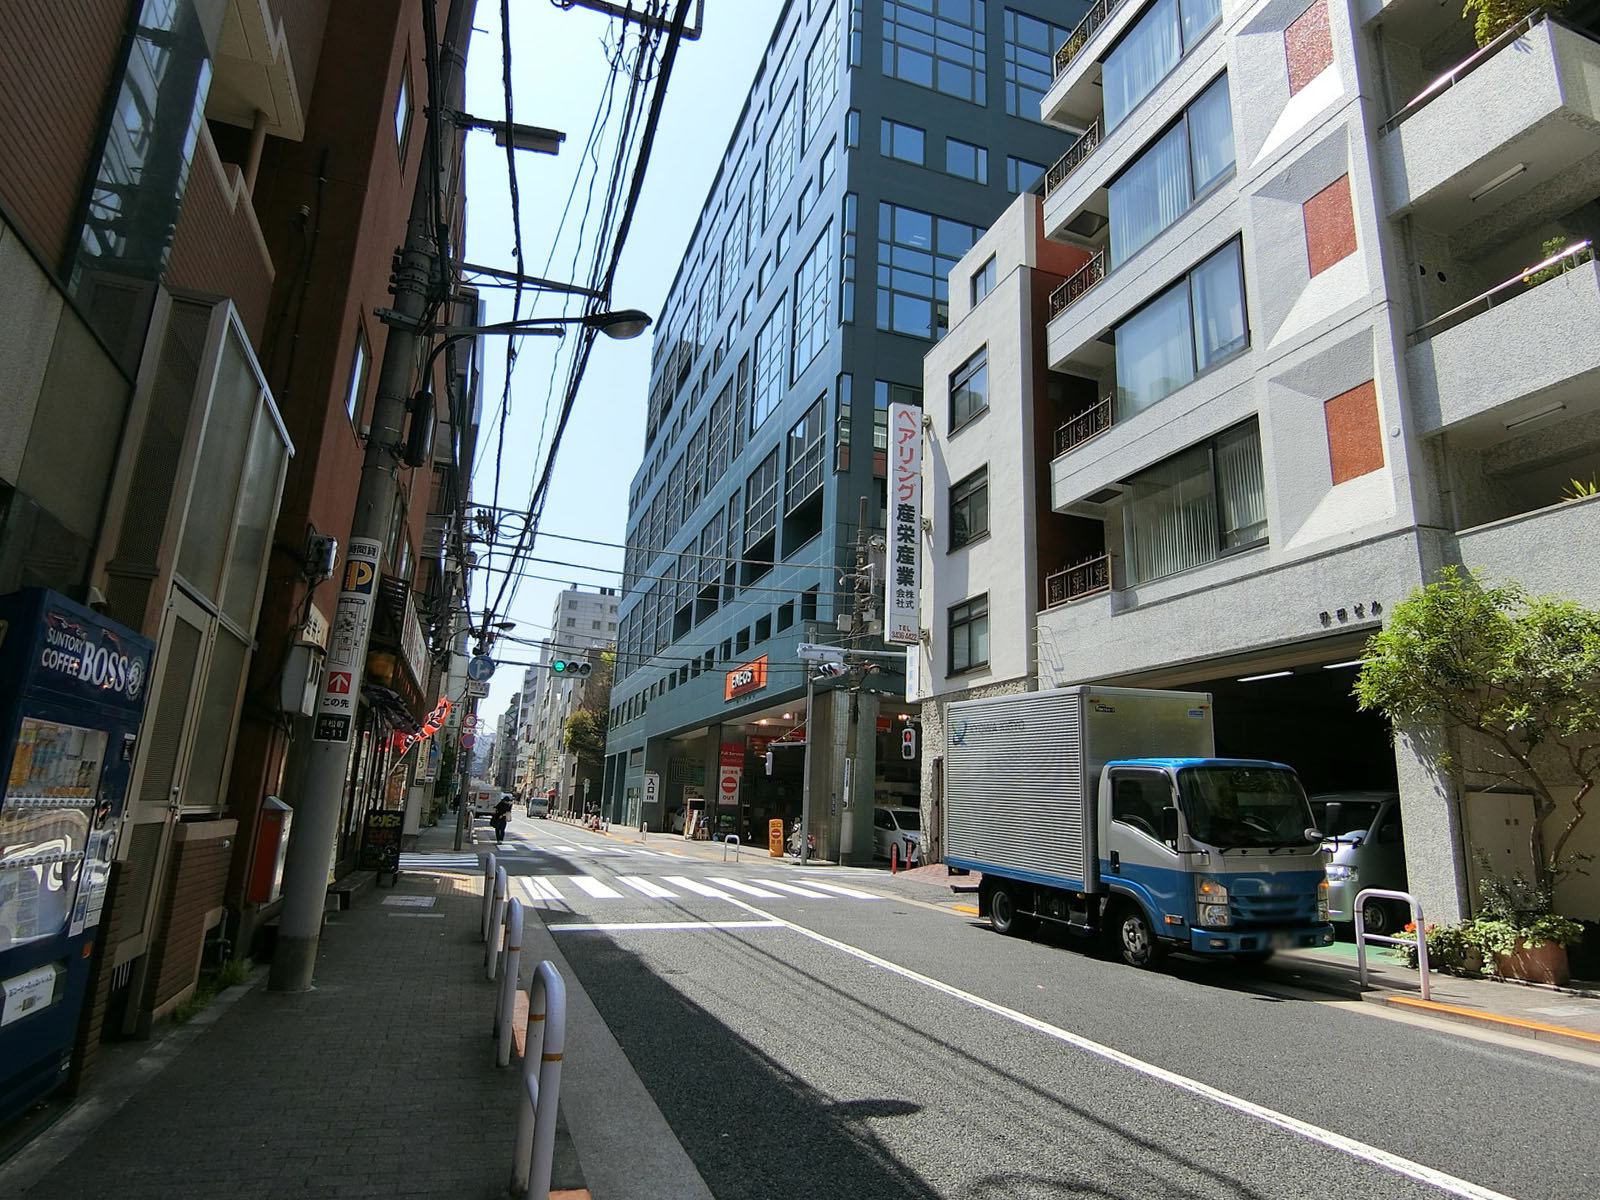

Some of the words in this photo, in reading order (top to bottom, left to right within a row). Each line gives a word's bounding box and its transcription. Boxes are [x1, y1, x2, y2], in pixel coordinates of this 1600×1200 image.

[898, 410, 917, 501] ベアリング
[46, 627, 87, 653] SUNTORY
[898, 624, 912, 632] TEL
[41, 647, 81, 676] COFFEE
[78, 641, 129, 692] BOSS
[731, 667, 753, 689] ENEOS
[323, 697, 351, 709] この先
[647, 777, 655, 793] 入口
